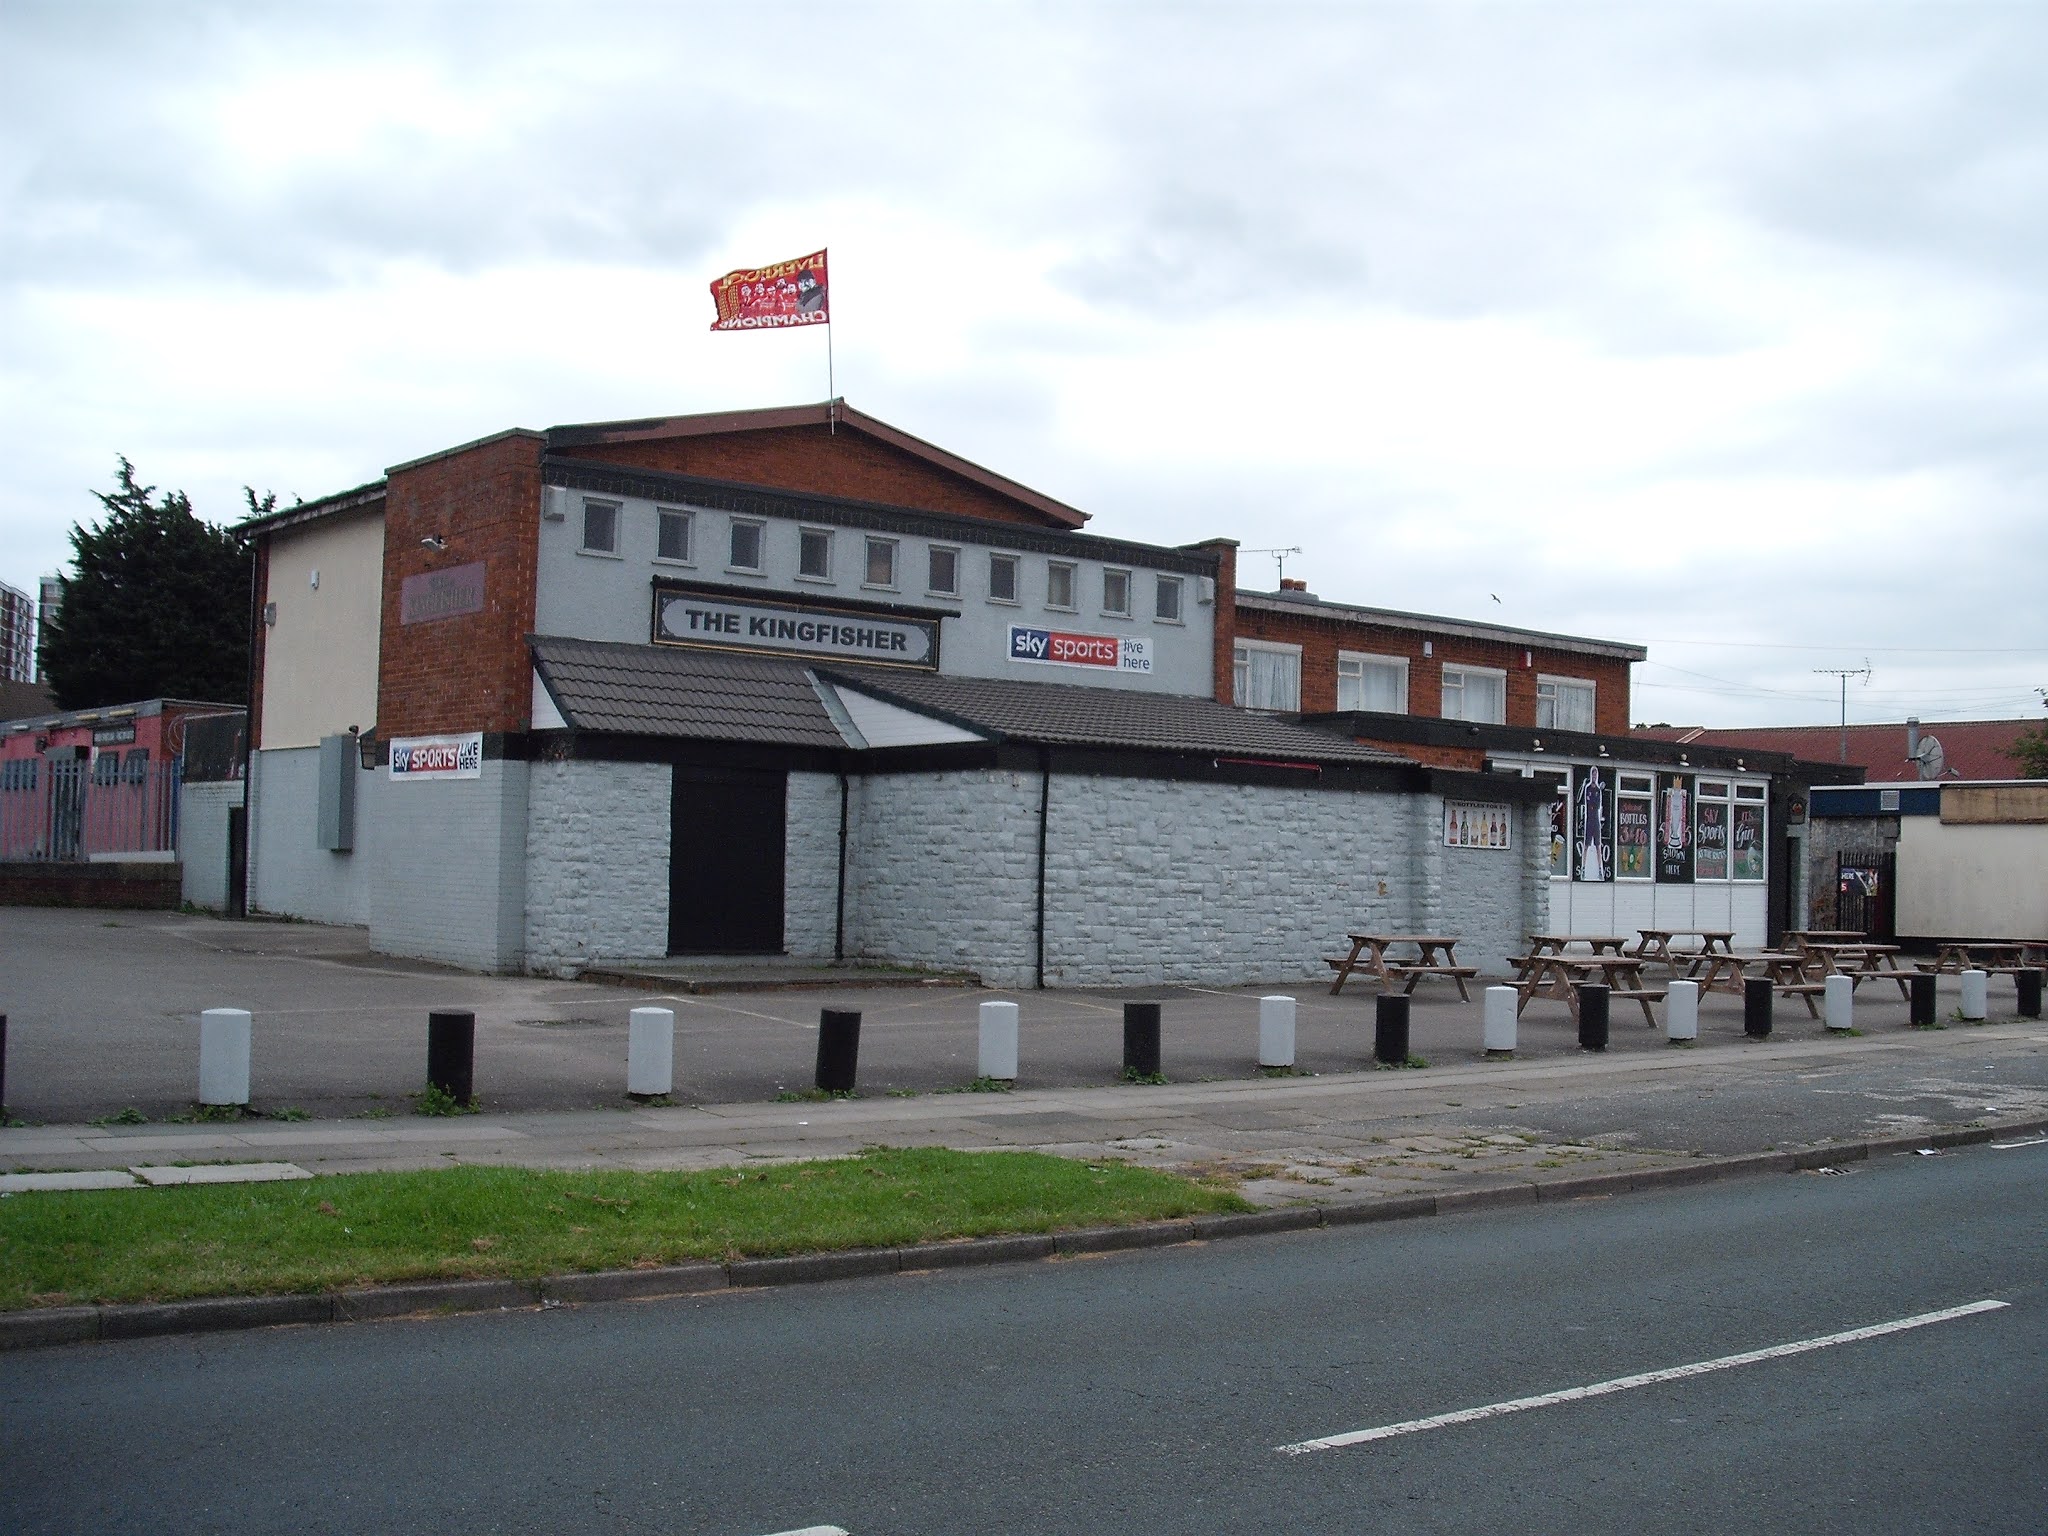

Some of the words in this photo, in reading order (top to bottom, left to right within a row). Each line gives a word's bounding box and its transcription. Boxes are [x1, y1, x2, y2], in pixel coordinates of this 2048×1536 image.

[685, 609, 740, 634] THE
[749, 616, 908, 651] KINGFISHER
[1015, 631, 1048, 658] sky
[1054, 639, 1114, 660] sports
[1123, 639, 1143, 653] live
[1123, 655, 1150, 670] here
[460, 742, 478, 756] LIVE
[395, 748, 410, 771] sky
[412, 748, 457, 768] SPORTS
[460, 757, 478, 769] HERE
[1620, 813, 1648, 825] BOTTLES
[1698, 824, 1726, 846] Sports
[1736, 824, 1754, 848] Gin
[1665, 864, 1681, 876] HERE
